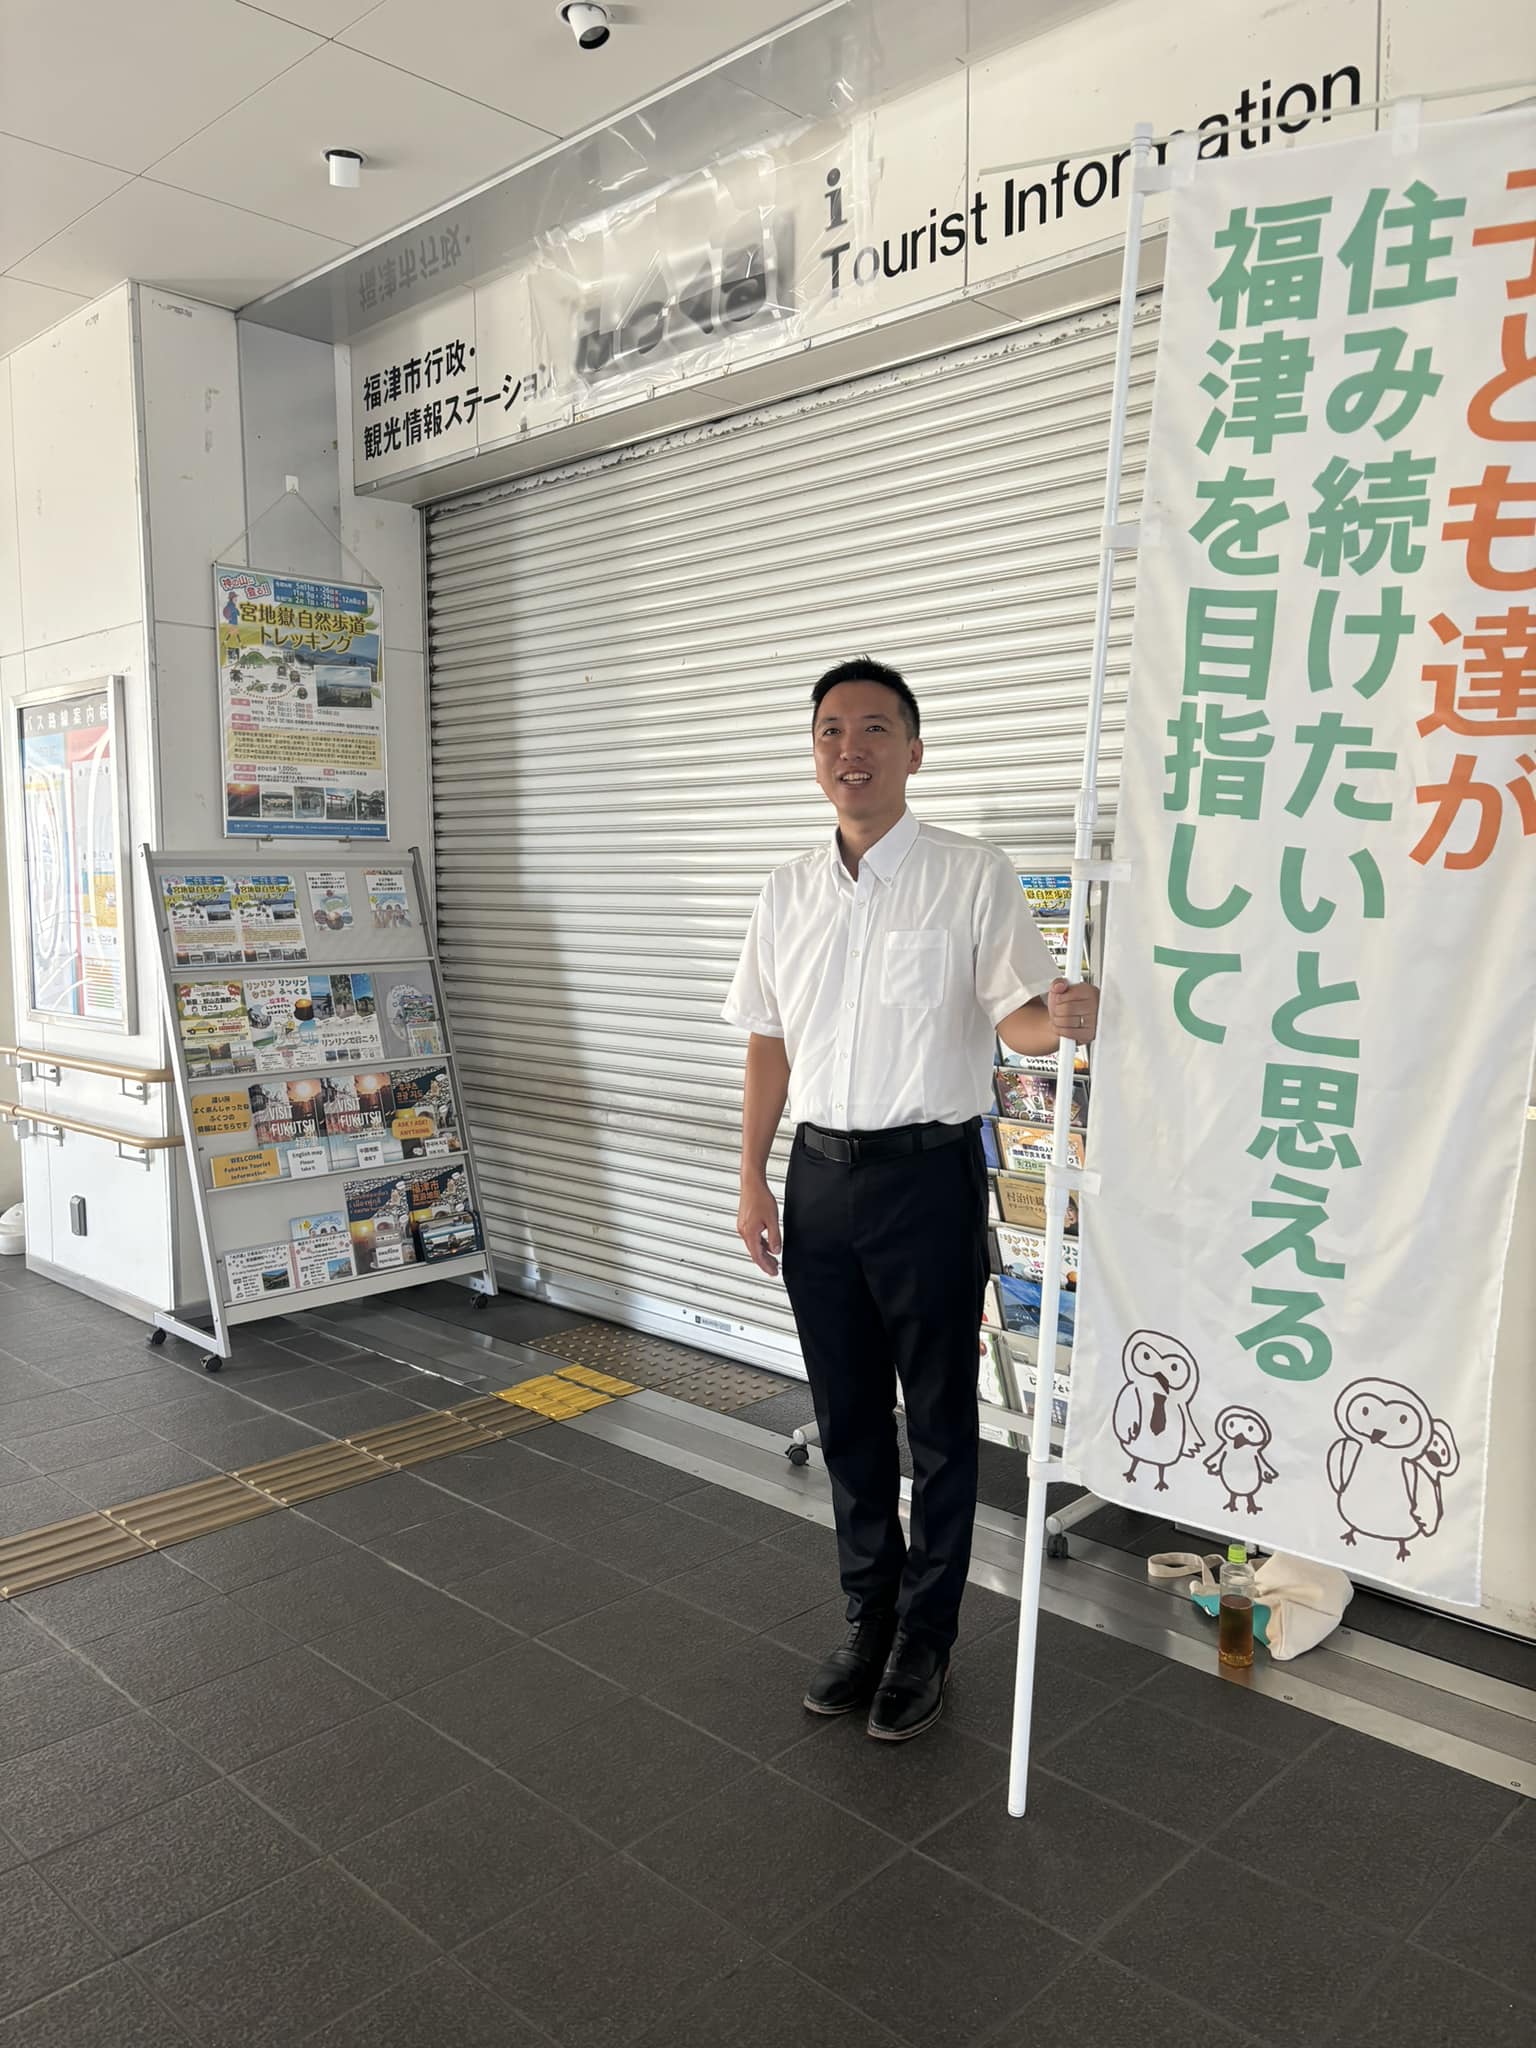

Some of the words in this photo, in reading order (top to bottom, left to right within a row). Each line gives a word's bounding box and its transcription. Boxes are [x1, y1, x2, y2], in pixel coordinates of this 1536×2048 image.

[819, 190, 988, 298] Tourist
[1003, 63, 1361, 237] Inforation
[363, 339, 477, 412] 福津市行政・
[240, 602, 367, 636] 宮地嶽自然歩道
[1152, 196, 1332, 1044] 福津を目指して
[260, 626, 352, 654] トレッキング
[1234, 180, 1467, 1382] 住み続けたいと思える
[278, 979, 307, 987] リンリン
[269, 1105, 293, 1119] VISIT
[337, 1097, 360, 1111] VISIT
[271, 1119, 316, 1137] FUKUTSU
[340, 1110, 381, 1128] FUKUTSU
[230, 1153, 262, 1164] WELCOME
